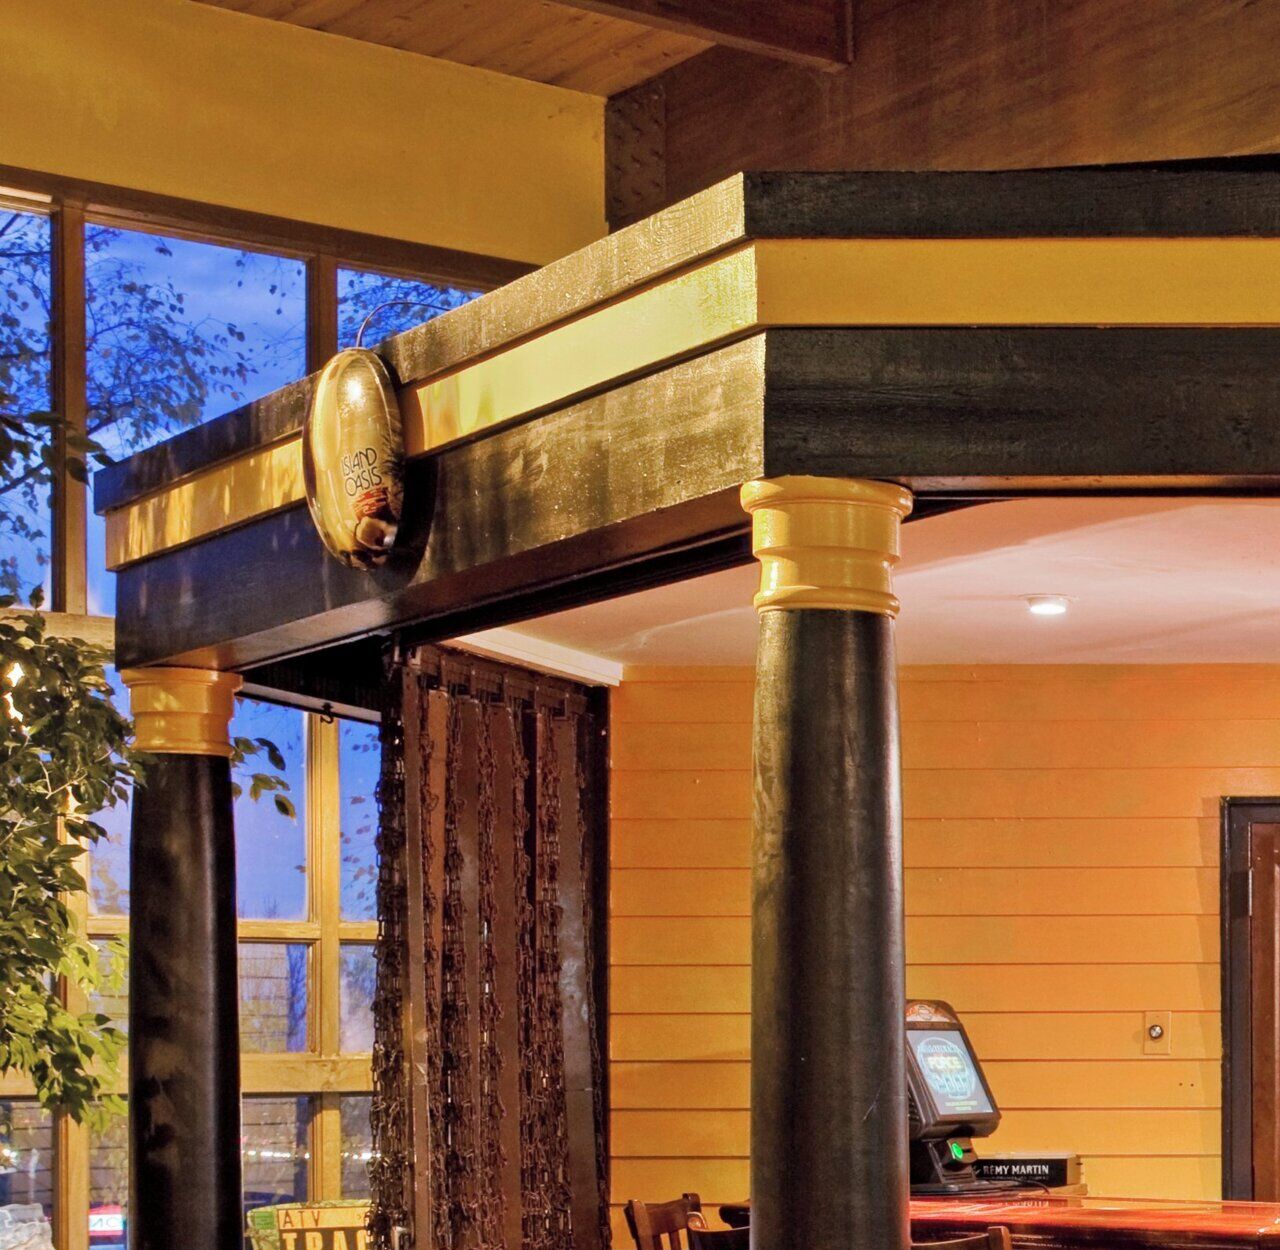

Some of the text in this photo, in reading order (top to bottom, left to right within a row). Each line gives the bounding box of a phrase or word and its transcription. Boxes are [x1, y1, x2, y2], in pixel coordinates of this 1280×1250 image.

[341, 447, 378, 477] ISLAND
[345, 466, 383, 497] OASIS
[1011, 1164, 1049, 1175] MARTIN
[282, 1209, 321, 1229] ATV
